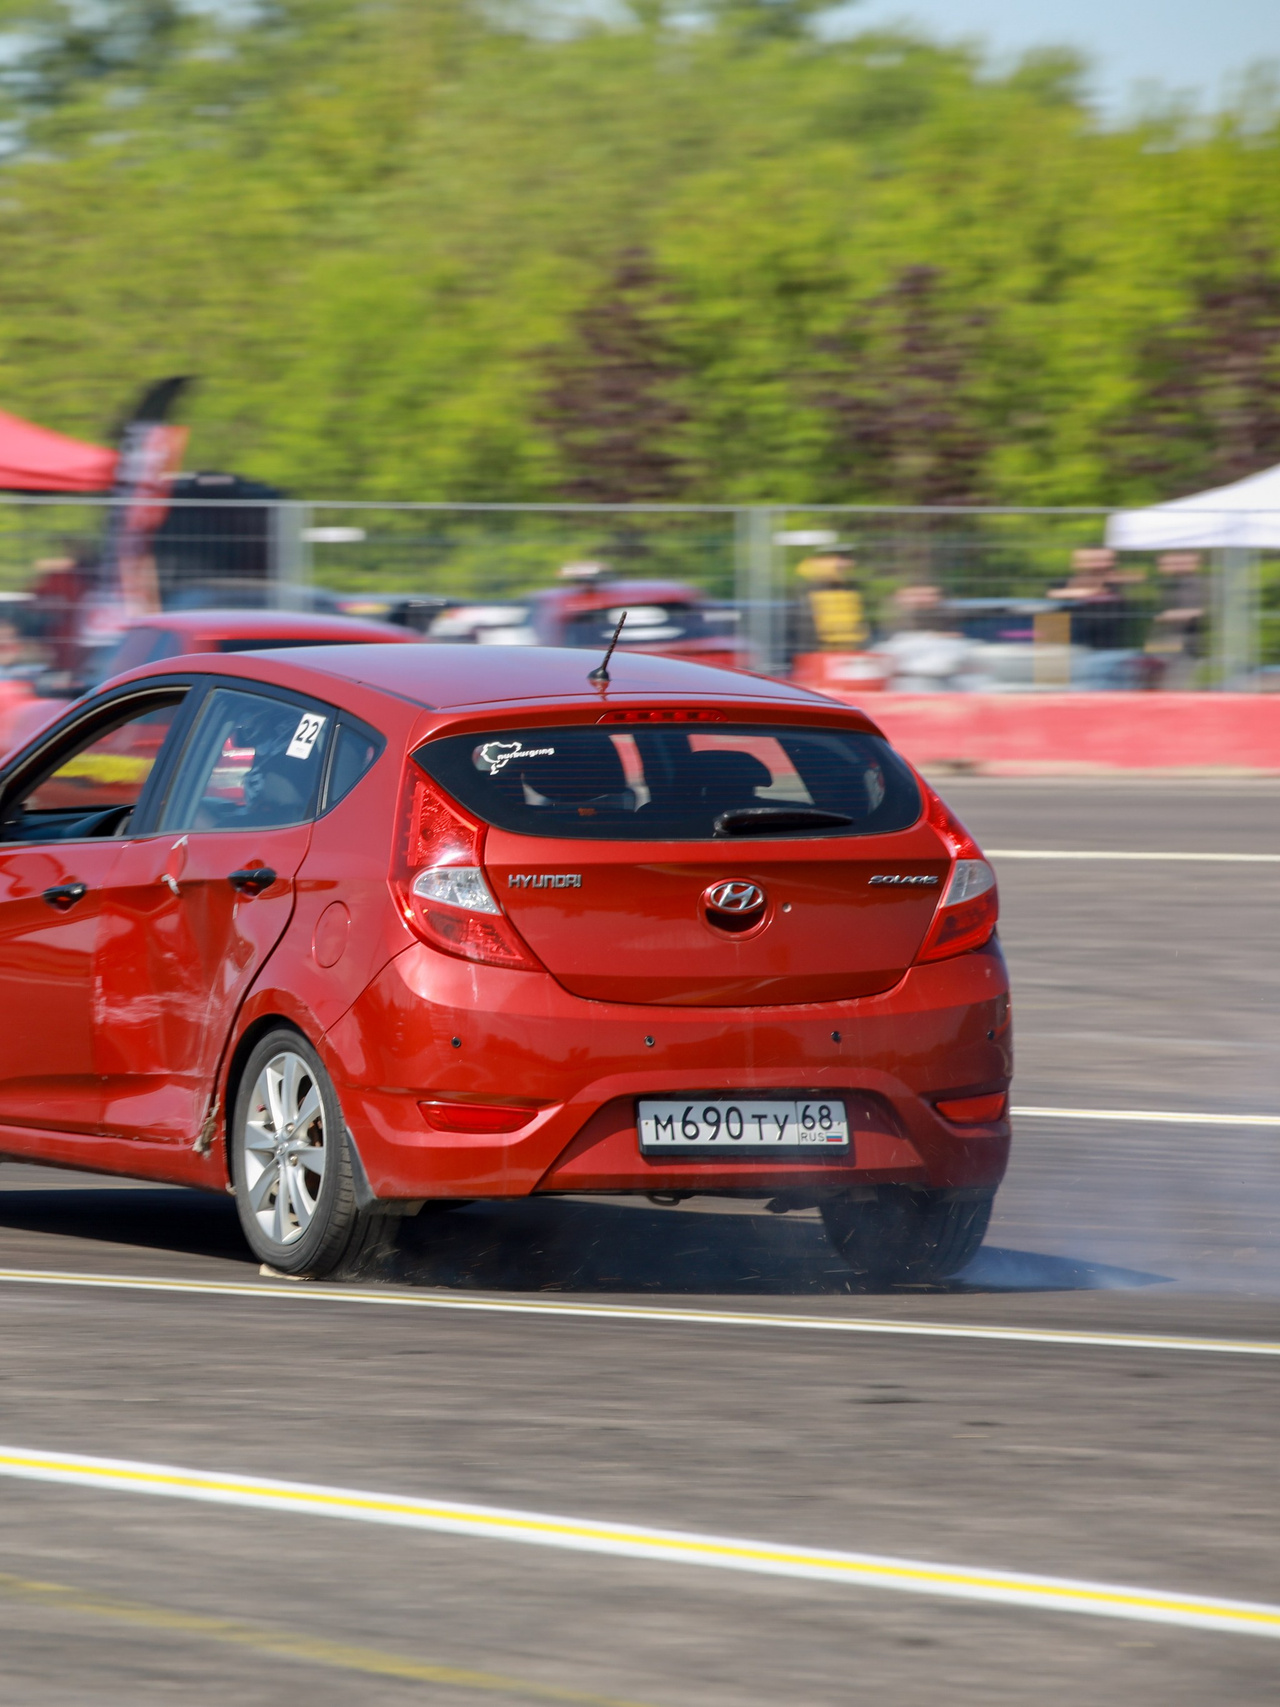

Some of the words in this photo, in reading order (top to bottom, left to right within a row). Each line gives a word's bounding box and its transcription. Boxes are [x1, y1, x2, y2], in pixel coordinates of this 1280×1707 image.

[295, 719, 319, 744] 22
[508, 874, 582, 888] HYUNDAI
[868, 874, 939, 884] SOLARIS
[801, 1104, 833, 1130] 68
[800, 1132, 826, 1142] RUS
